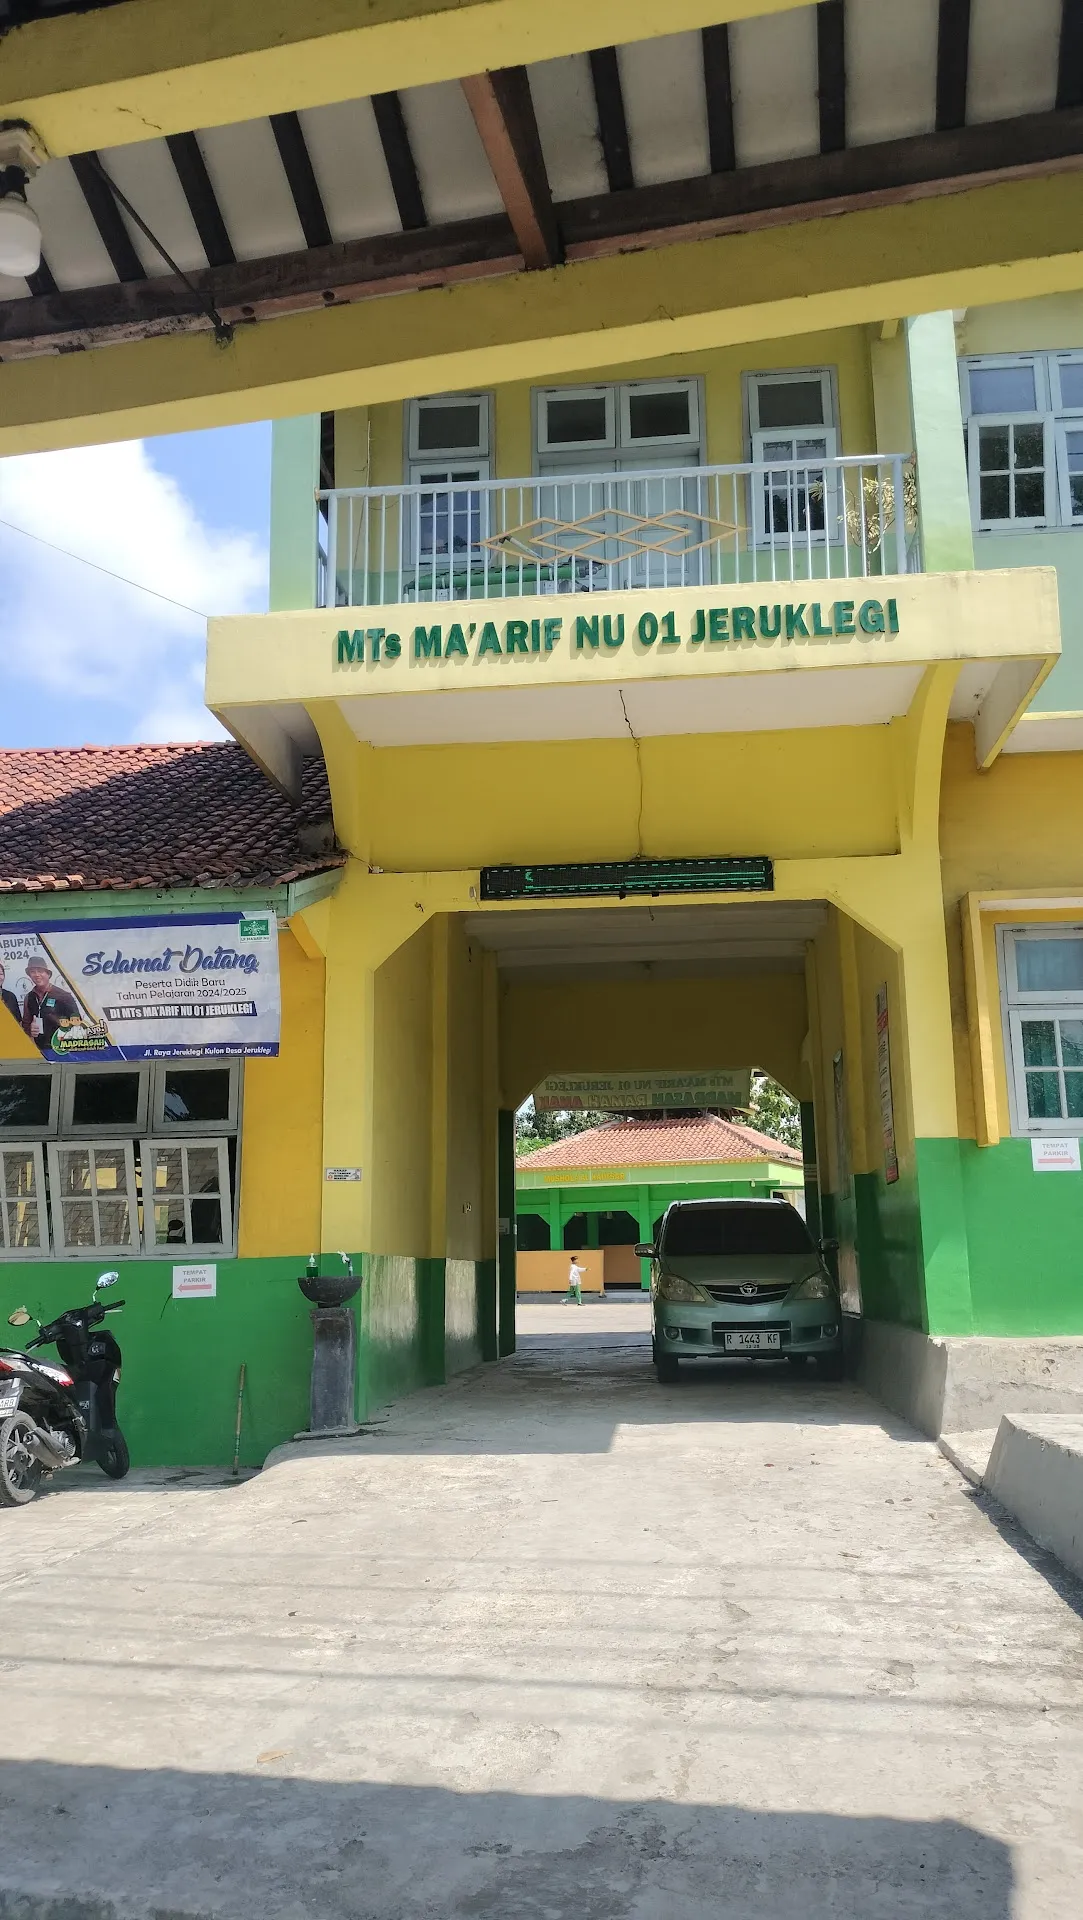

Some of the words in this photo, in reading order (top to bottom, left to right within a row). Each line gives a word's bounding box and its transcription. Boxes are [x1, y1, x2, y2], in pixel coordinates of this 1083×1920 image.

[337, 627, 402, 663] MTs
[414, 617, 563, 658] MA'ARIF
[576, 613, 625, 649] NU
[638, 611, 681, 646] 01
[691, 598, 900, 644] JERUKLEGI
[3, 950, 30, 960] 2024
[82, 948, 184, 976] Selamat
[179, 944, 260, 974] Datang
[135, 980, 172, 990] Peserta
[174, 978, 199, 988] Didik
[201, 977, 226, 987] Baru
[116, 991, 147, 1001] Tahun
[149, 988, 195, 1000] Pelajaran
[197, 987, 247, 997] 2024/2025
[110, 1008, 121, 1019] DI
[122, 1007, 142, 1019] MTs
[143, 1005, 180, 1018] MA'ARIF
[180, 1005, 193, 1016] NU
[194, 1005, 204, 1016] 01
[206, 1003, 253, 1016] JERUKLEGI
[154, 1049, 171, 1057] Raya
[172, 1048, 202, 1057] Jeruklegi
[205, 1047, 224, 1055] Kulon
[243, 1046, 271, 1055] Jeruklegi
[726, 1334, 732, 1344] R
[739, 1334, 760, 1344] 1443
[767, 1333, 778, 1344] KF
